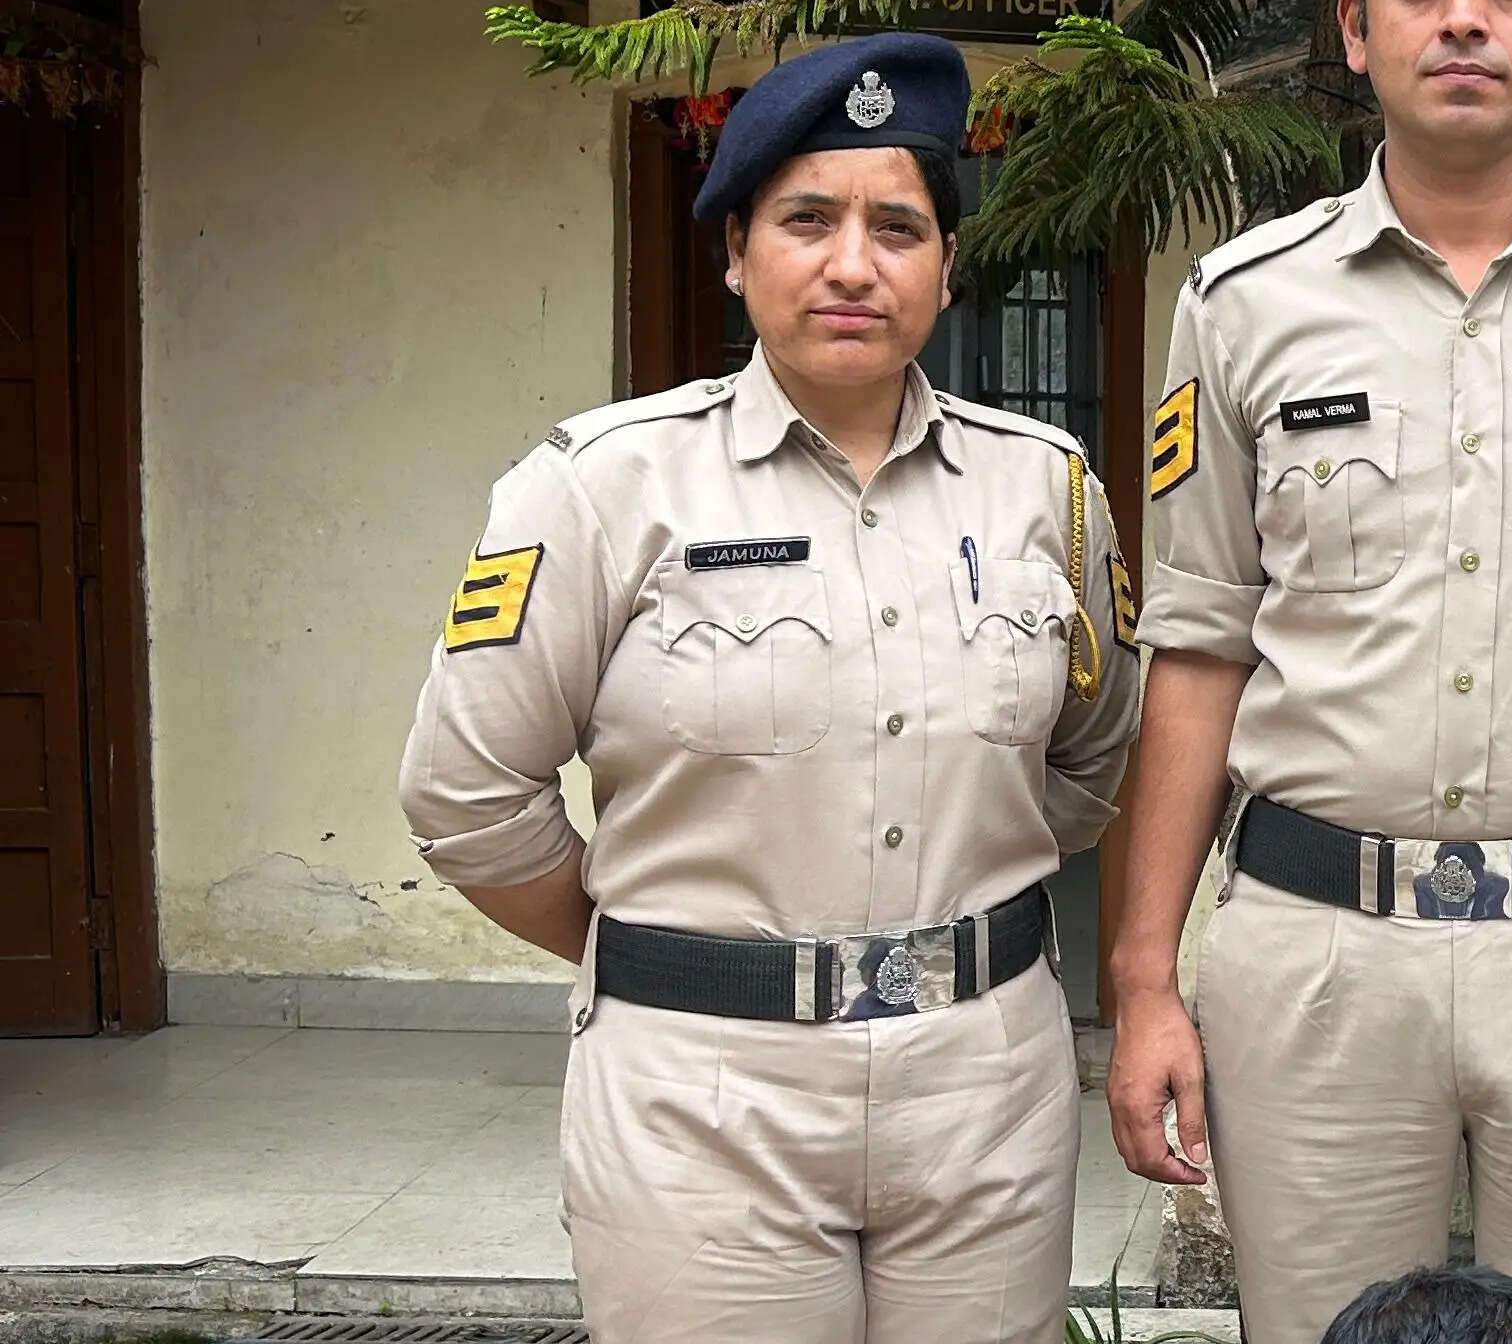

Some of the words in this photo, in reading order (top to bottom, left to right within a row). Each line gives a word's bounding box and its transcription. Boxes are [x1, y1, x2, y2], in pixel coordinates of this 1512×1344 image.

[1292, 407, 1323, 420] KAMAL
[1323, 403, 1356, 417] VERMA
[707, 545, 790, 563] JAMUNA
